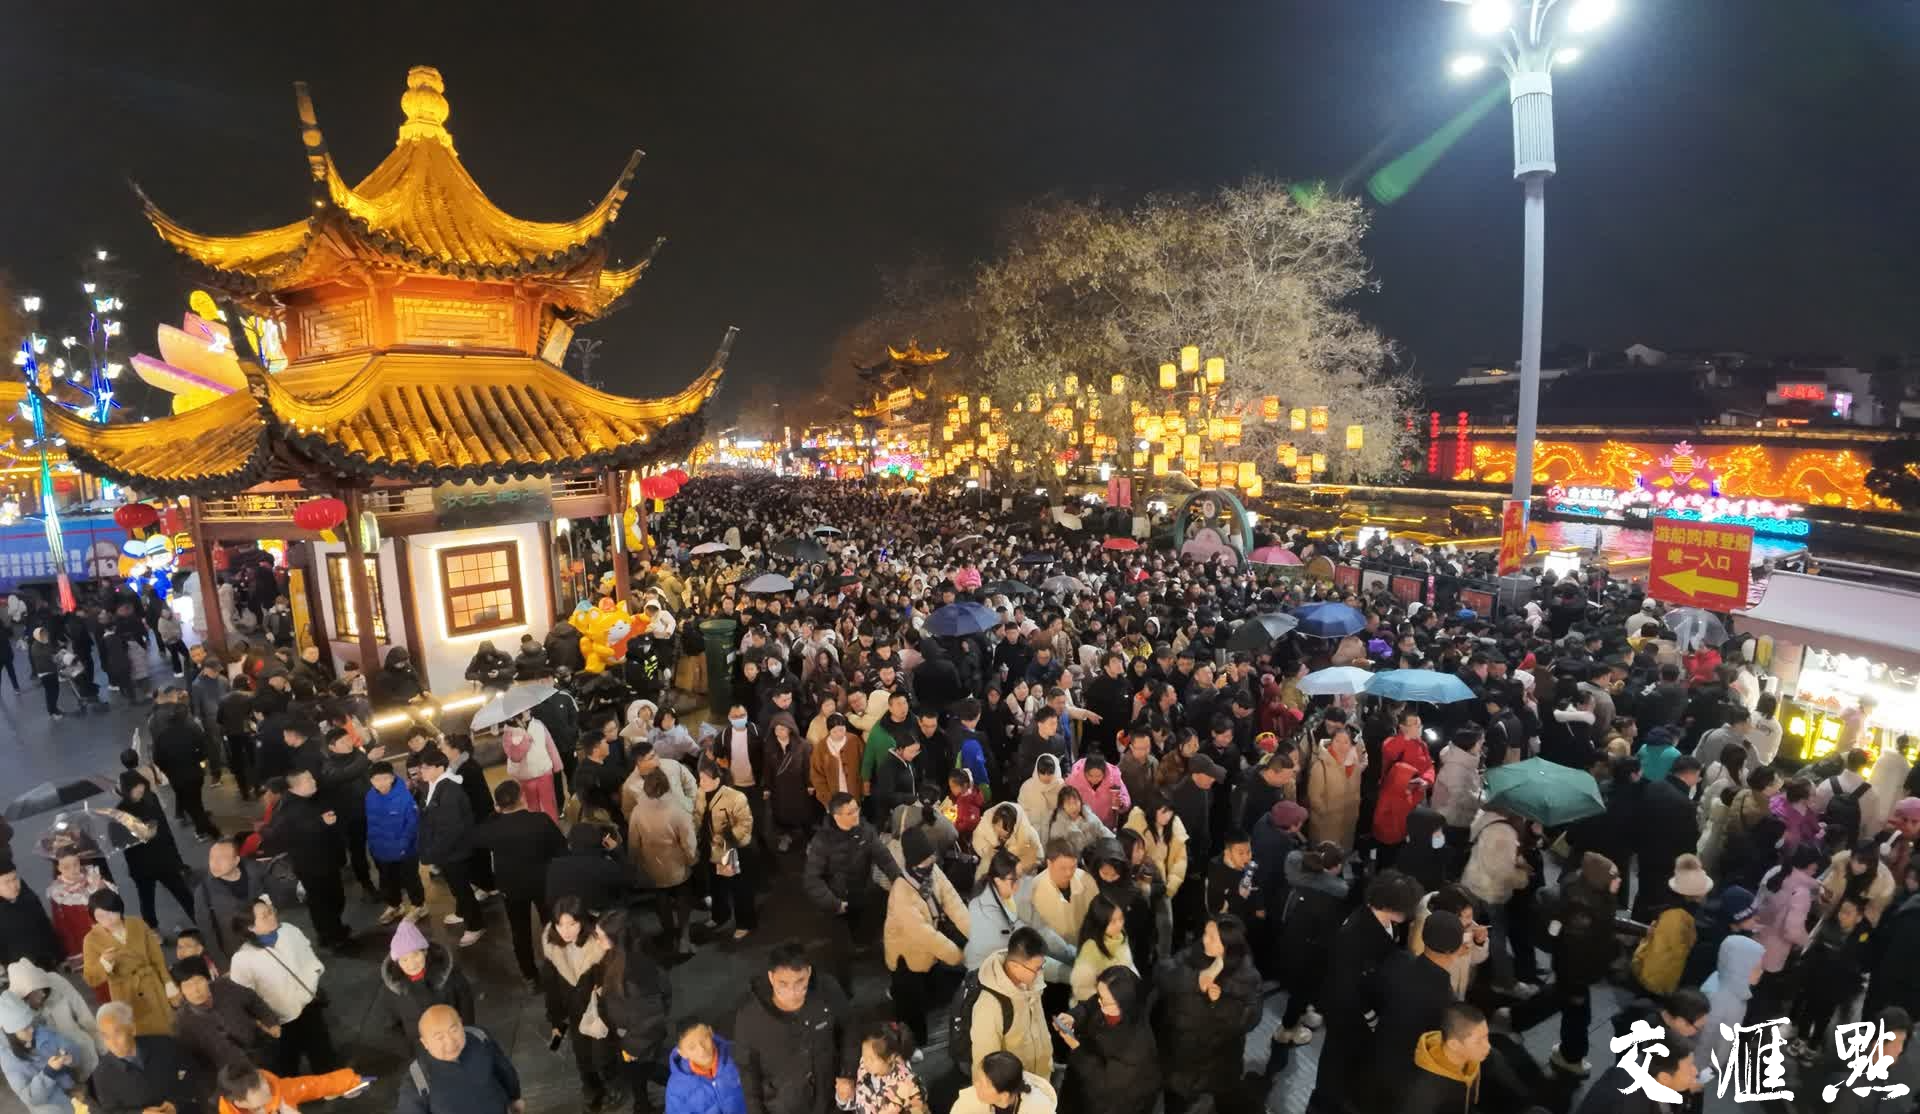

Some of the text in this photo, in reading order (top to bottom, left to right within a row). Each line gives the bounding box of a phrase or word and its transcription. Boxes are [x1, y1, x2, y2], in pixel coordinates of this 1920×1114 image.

[1655, 525, 1751, 552] 游船购票登船
[1667, 547, 1731, 571] 唯一入口
